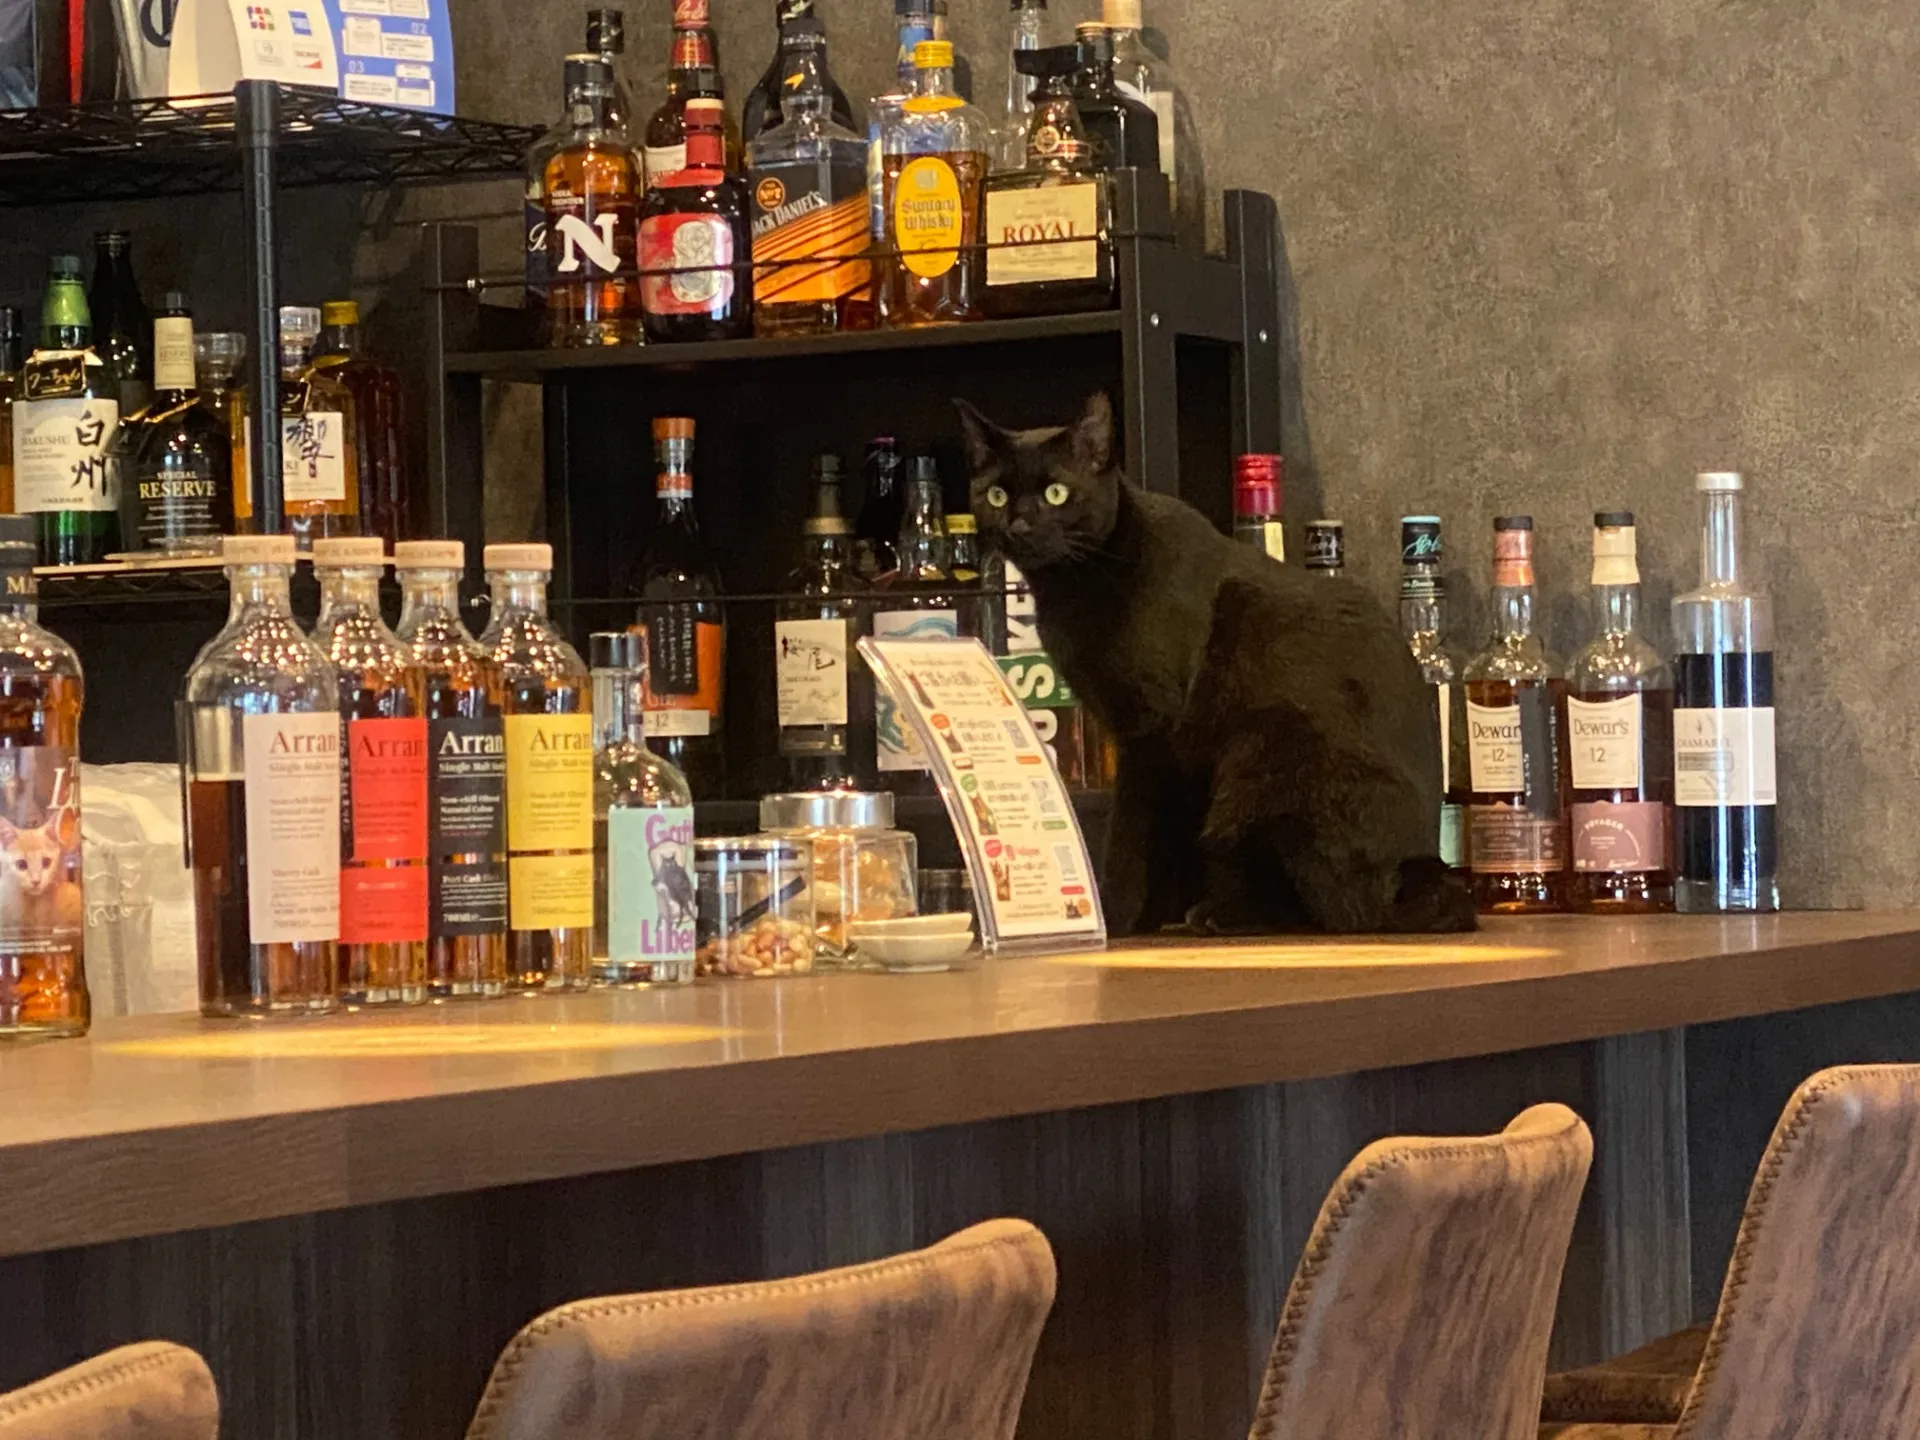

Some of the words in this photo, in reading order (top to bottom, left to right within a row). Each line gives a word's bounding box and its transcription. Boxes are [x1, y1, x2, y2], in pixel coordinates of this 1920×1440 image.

[555, 213, 622, 273] N
[71, 410, 107, 496] 白州
[139, 480, 217, 499] RESERVE
[1573, 718, 1629, 736] Dewar's
[268, 730, 336, 754] Arran
[356, 735, 423, 757] Arran
[439, 730, 504, 755] Arran
[530, 729, 591, 750] Arran
[1492, 748, 1505, 762] 12
[1589, 747, 1606, 763] 12
